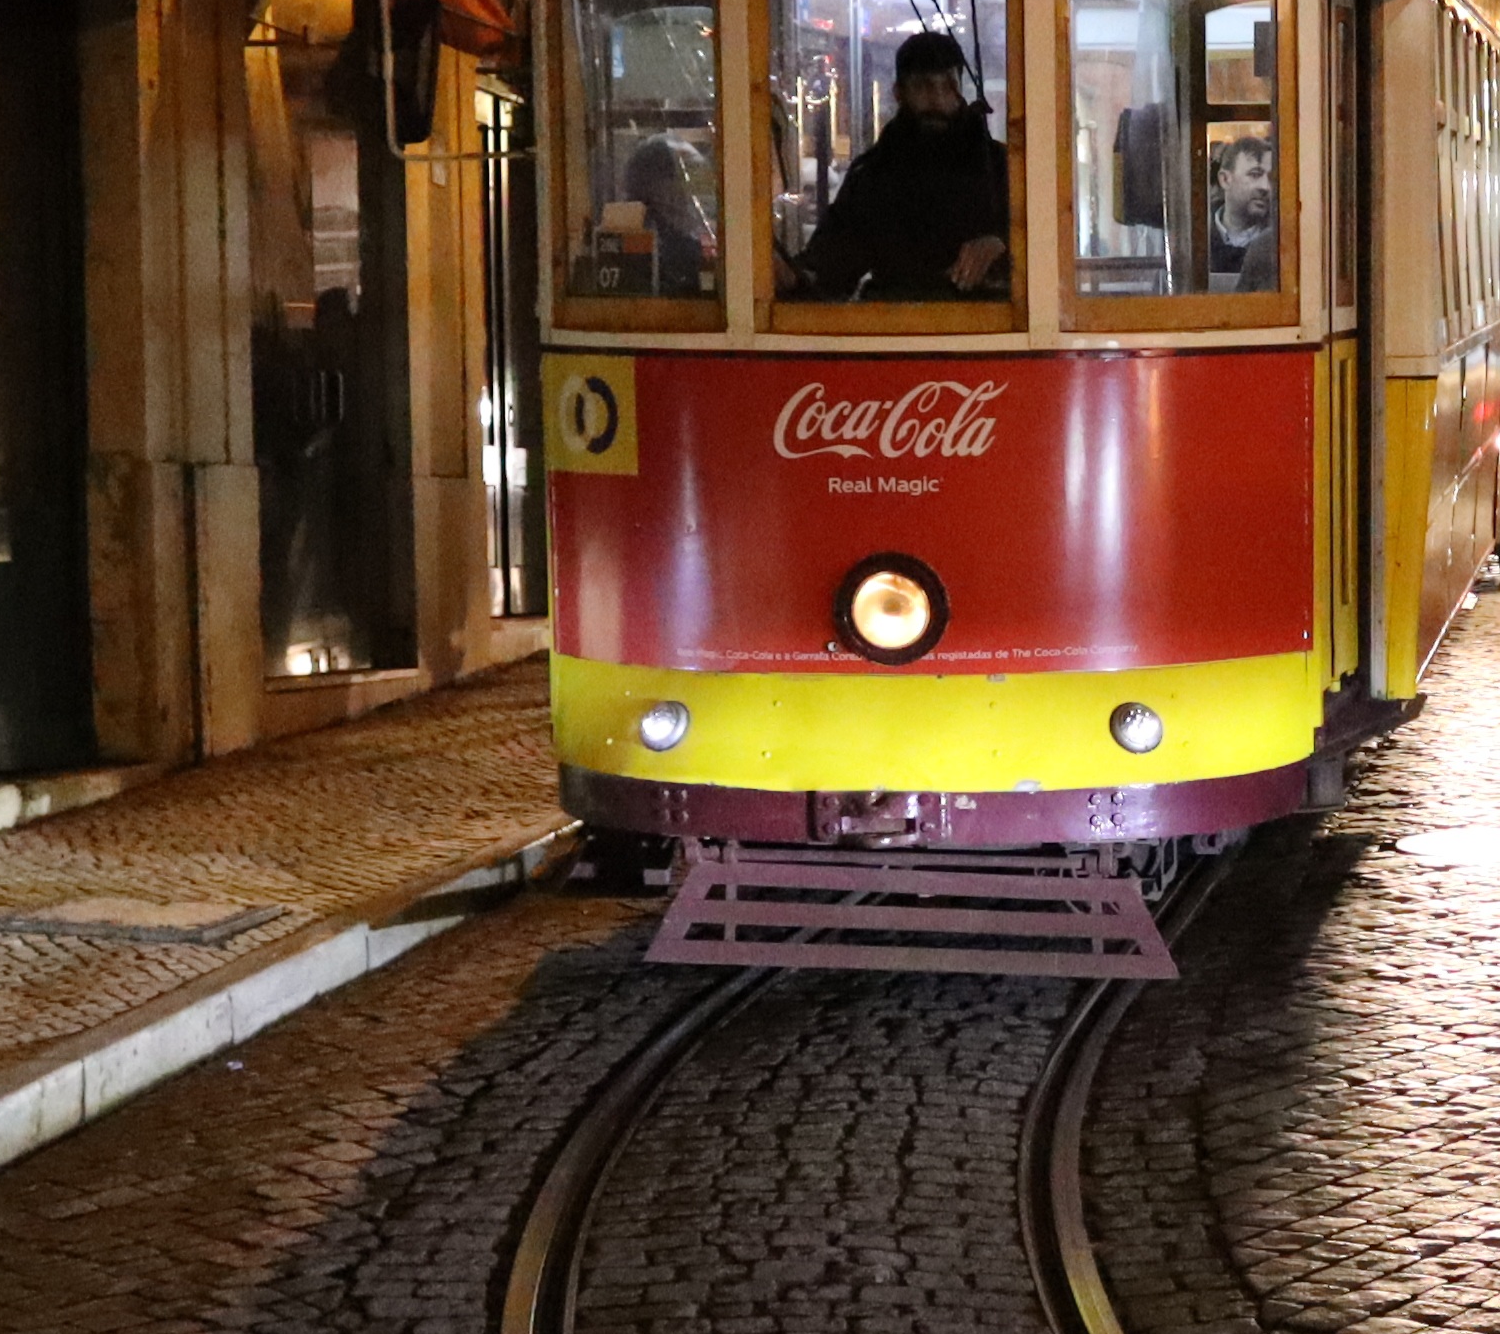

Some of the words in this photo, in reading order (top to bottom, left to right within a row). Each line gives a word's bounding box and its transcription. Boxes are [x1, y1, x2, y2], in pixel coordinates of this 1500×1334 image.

[600, 267, 620, 288] 07
[773, 380, 1009, 459] Coca-Cola
[827, 476, 873, 494] Real
[878, 475, 940, 496] Magic
[1012, 648, 1031, 658] The
[1034, 645, 1087, 657] Coca-Cola
